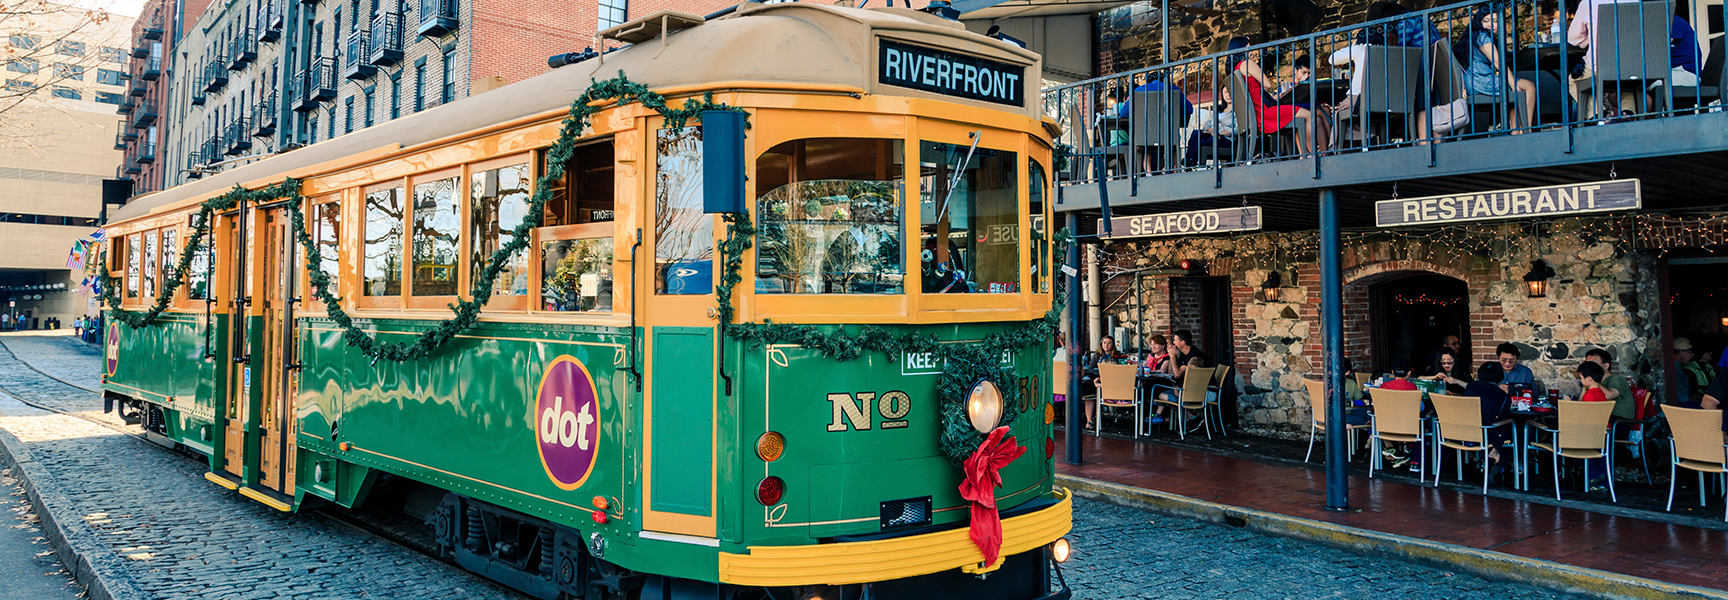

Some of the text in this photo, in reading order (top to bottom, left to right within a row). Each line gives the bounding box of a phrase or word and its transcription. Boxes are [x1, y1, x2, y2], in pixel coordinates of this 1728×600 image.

[885, 47, 1019, 101] RIVERFRONT
[1402, 184, 1601, 223] RESTAURANT
[1129, 212, 1220, 236] SEAFOOD
[1016, 375, 1039, 414] 56
[541, 396, 594, 450] dot
